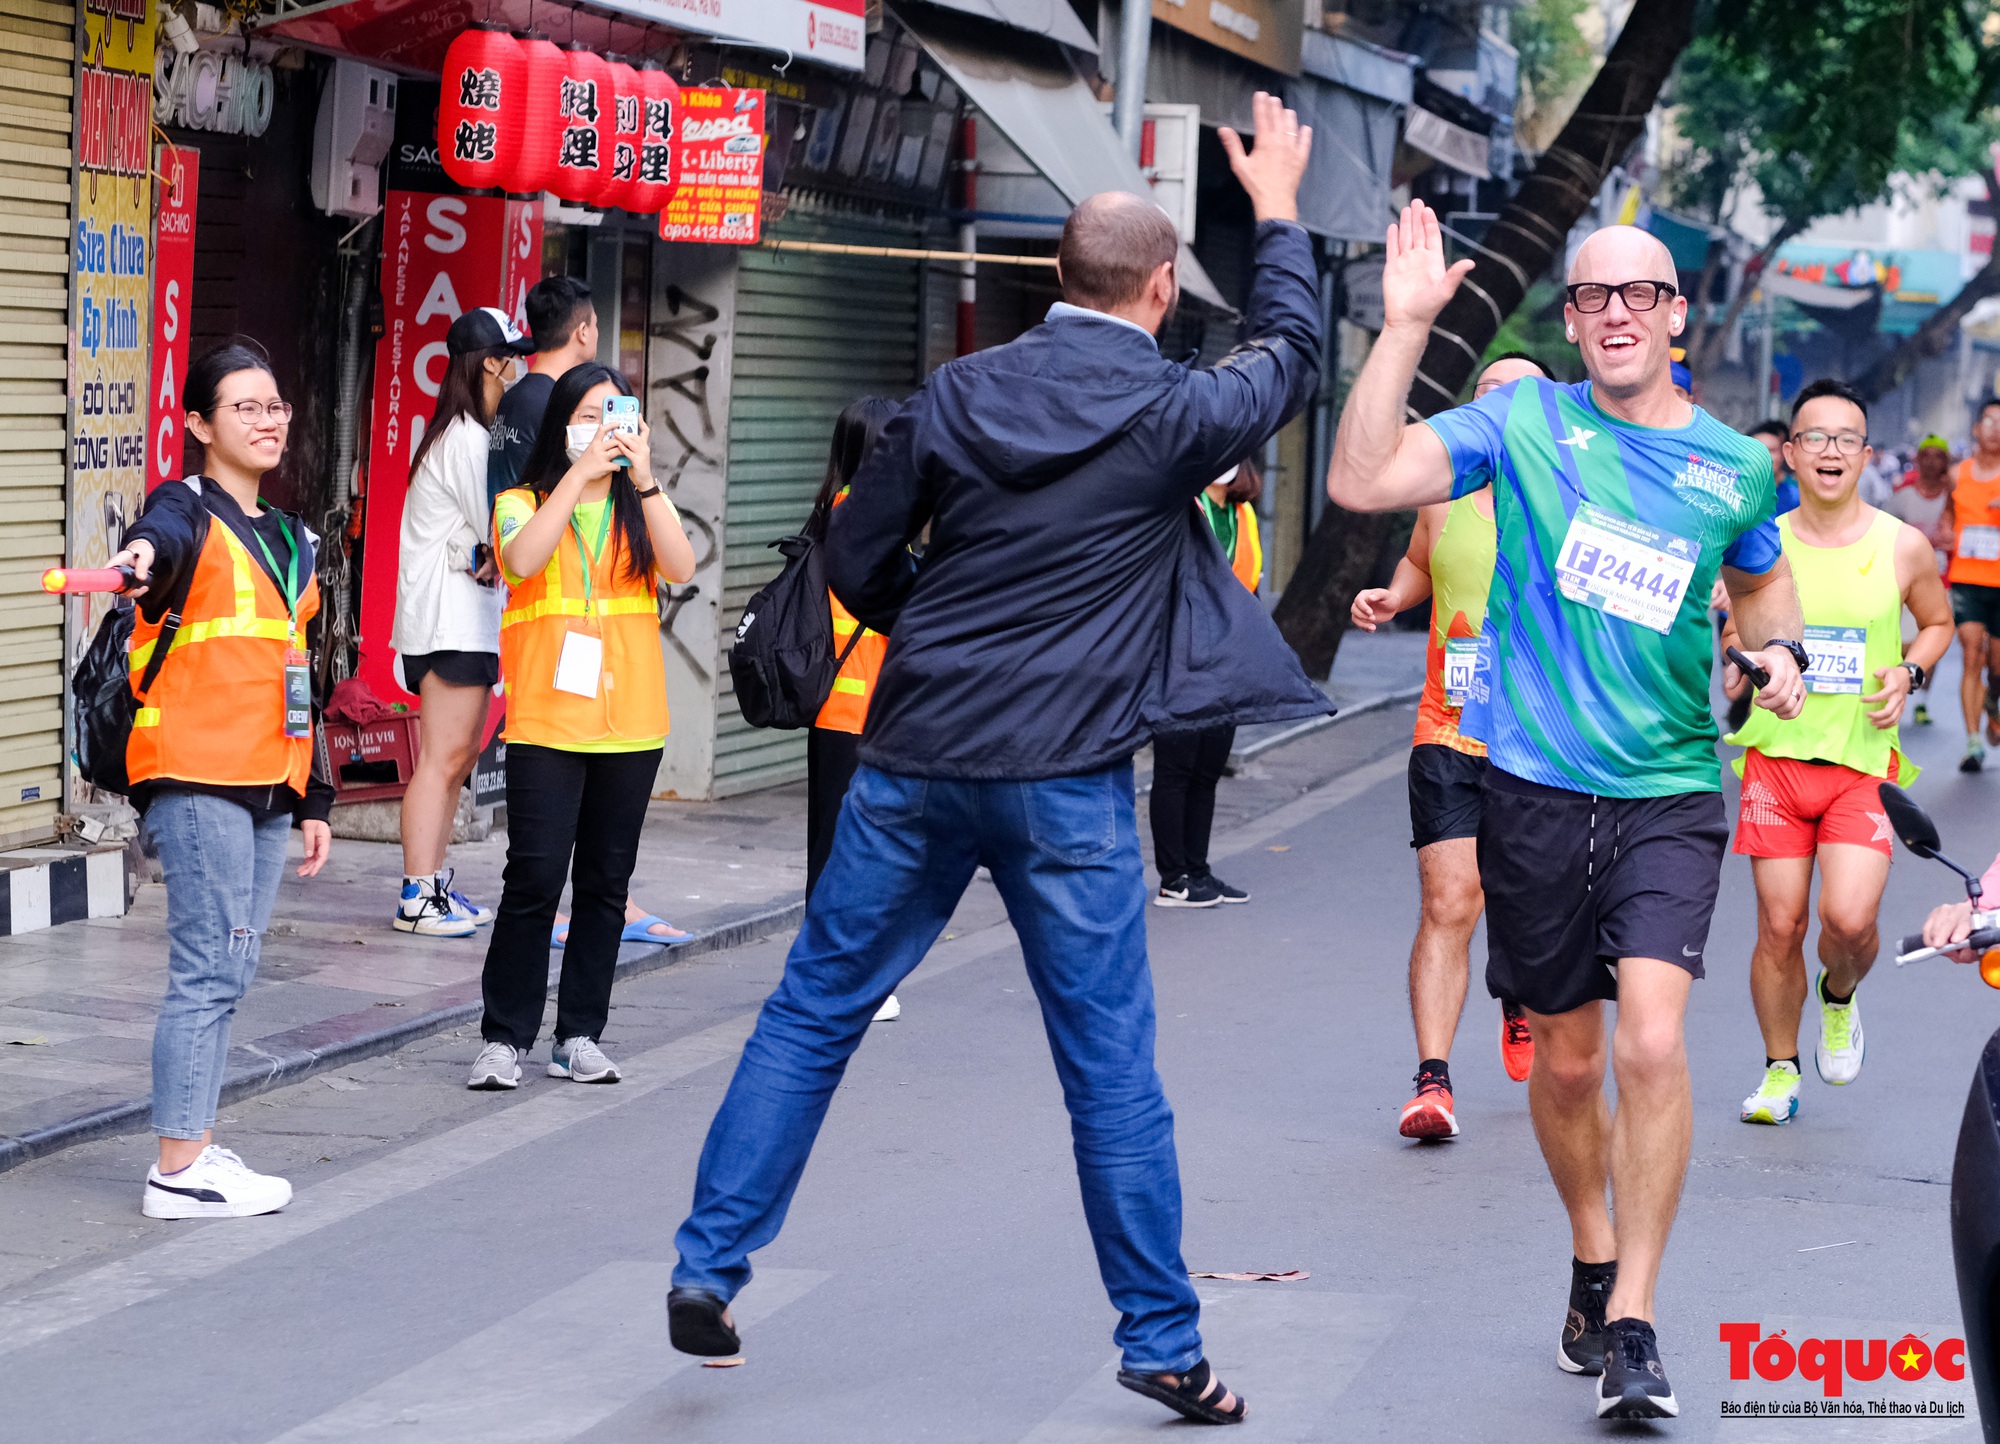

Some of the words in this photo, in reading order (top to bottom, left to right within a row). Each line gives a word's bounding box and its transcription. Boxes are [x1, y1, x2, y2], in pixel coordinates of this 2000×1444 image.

[153, 44, 274, 137] SACHIKO
[559, 75, 600, 170] 料理
[699, 149, 758, 173] Liberty
[161, 211, 190, 234] SACHIKO
[668, 213, 696, 225] THAY
[698, 214, 718, 225] PIN
[77, 217, 105, 274] Sửa
[110, 223, 144, 275] Chữa
[395, 197, 411, 306] JAPANESE
[106, 298, 138, 349] Kính
[386, 318, 404, 456] RESTAURANT
[1686, 462, 1736, 490] HANOI
[1702, 459, 1740, 478] VPBank
[1673, 471, 1743, 512] MARATHON
[1573, 543, 1595, 571] F
[1598, 554, 1681, 603] 24444
[1614, 591, 1646, 608] MICHAEL
[1645, 602, 1677, 618] EDWARD
[1453, 667, 1467, 686] M
[1807, 652, 1858, 674] 27754
[288, 709, 309, 724] CREW
